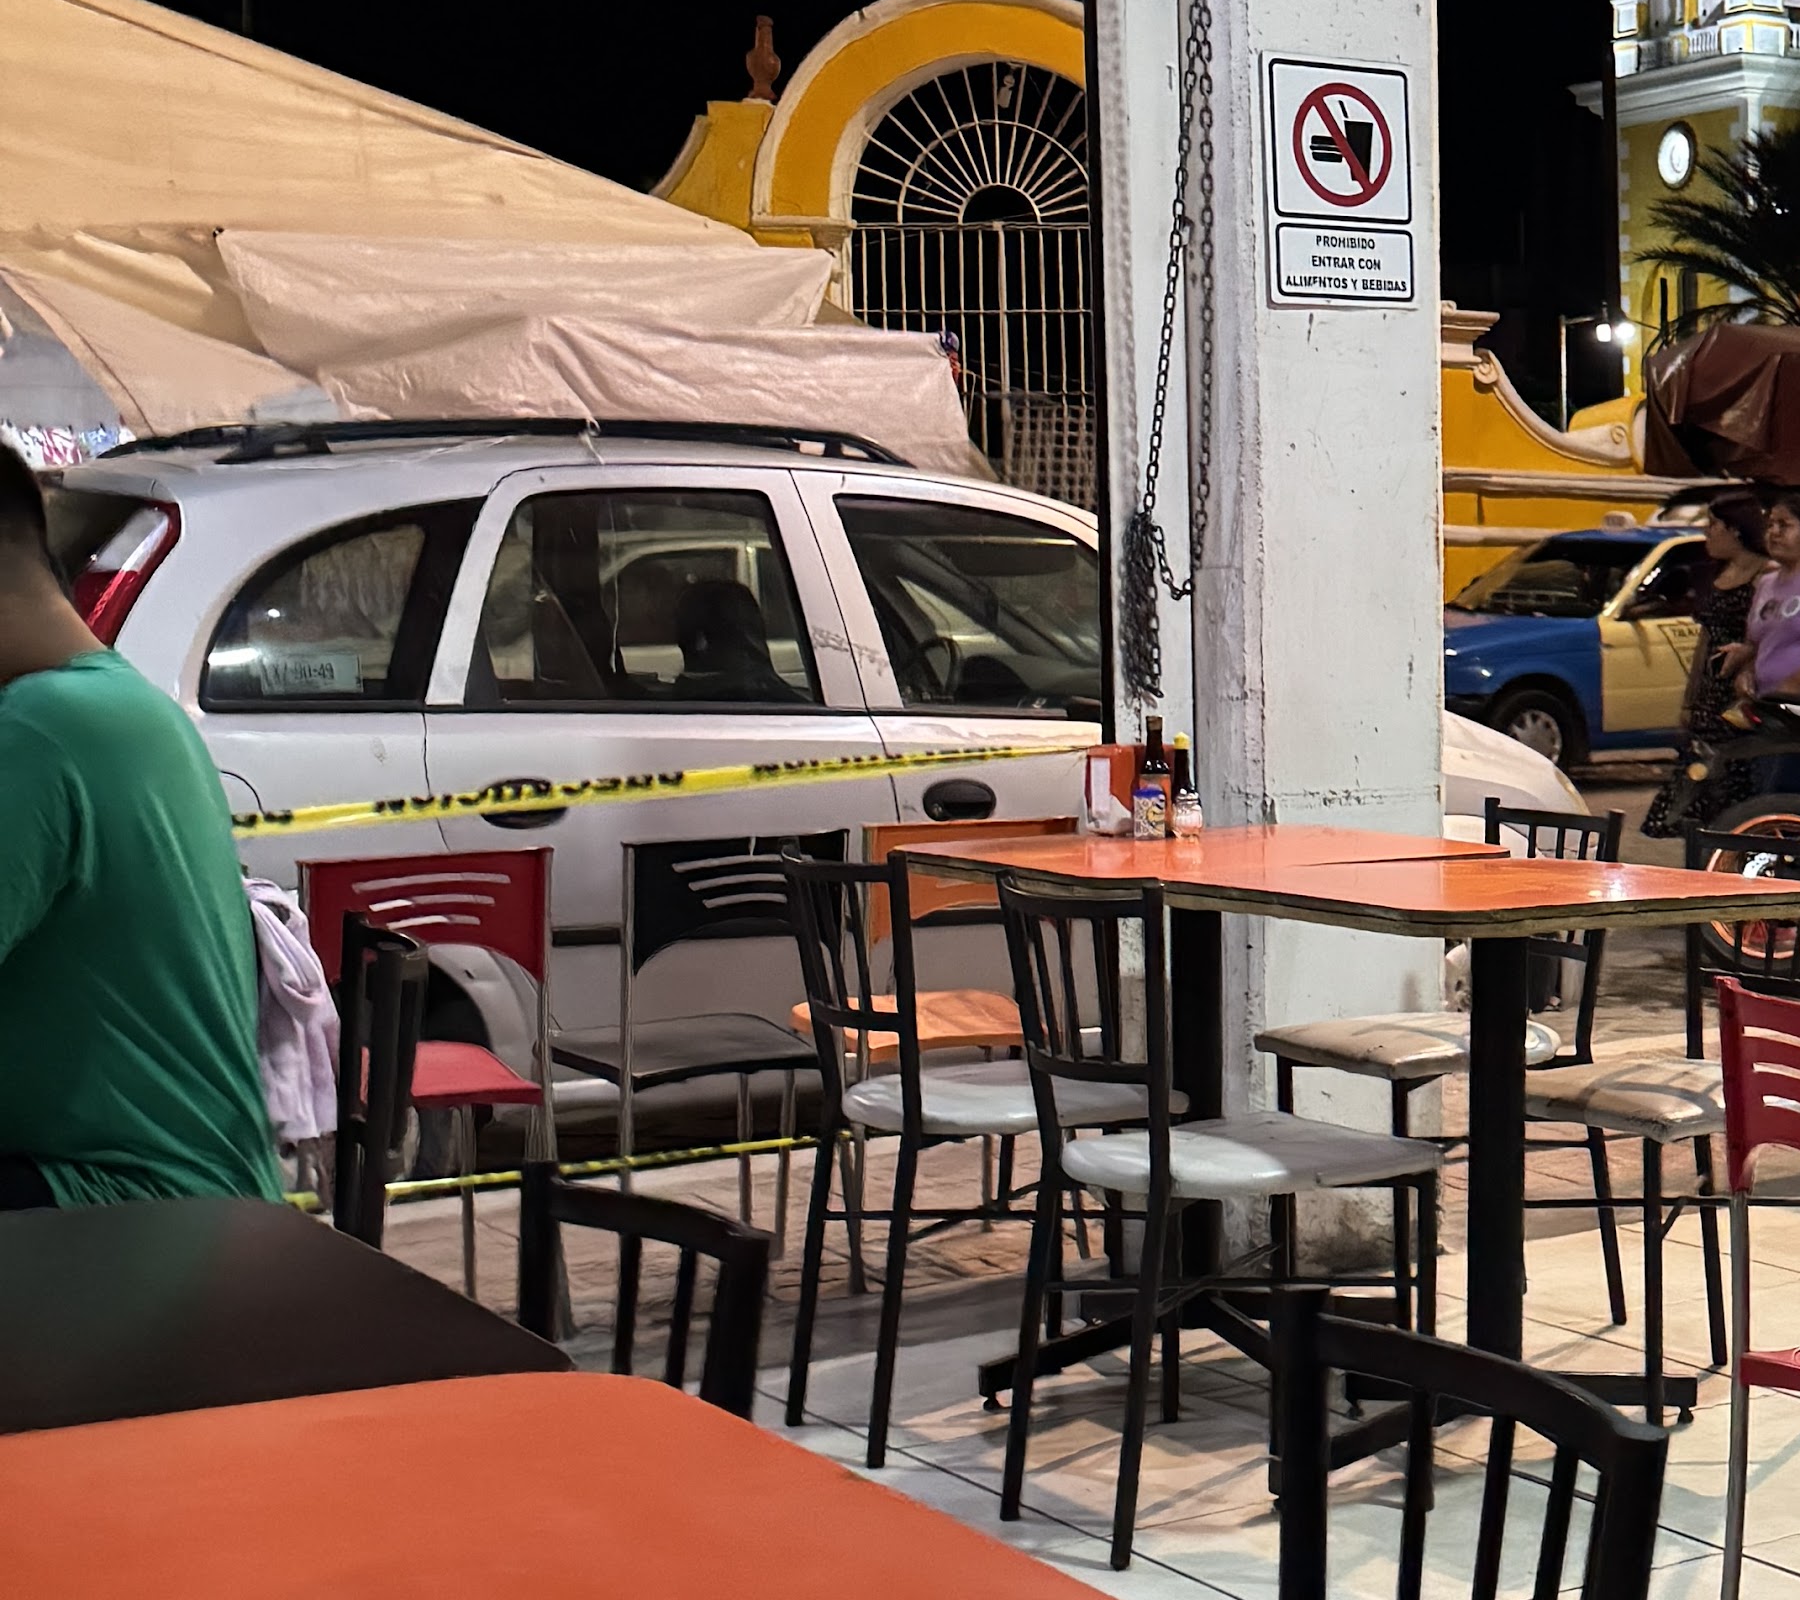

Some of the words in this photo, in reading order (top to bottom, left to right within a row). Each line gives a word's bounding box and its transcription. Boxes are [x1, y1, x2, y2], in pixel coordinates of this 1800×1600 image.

[1316, 235, 1376, 250] PROHIBIDO
[1311, 255, 1356, 270] ENTRAR
[1358, 258, 1381, 271] CON
[1286, 275, 1348, 289] ALIMENTOS
[1351, 279, 1358, 290] Y
[1362, 278, 1407, 292] BEBIDAS
